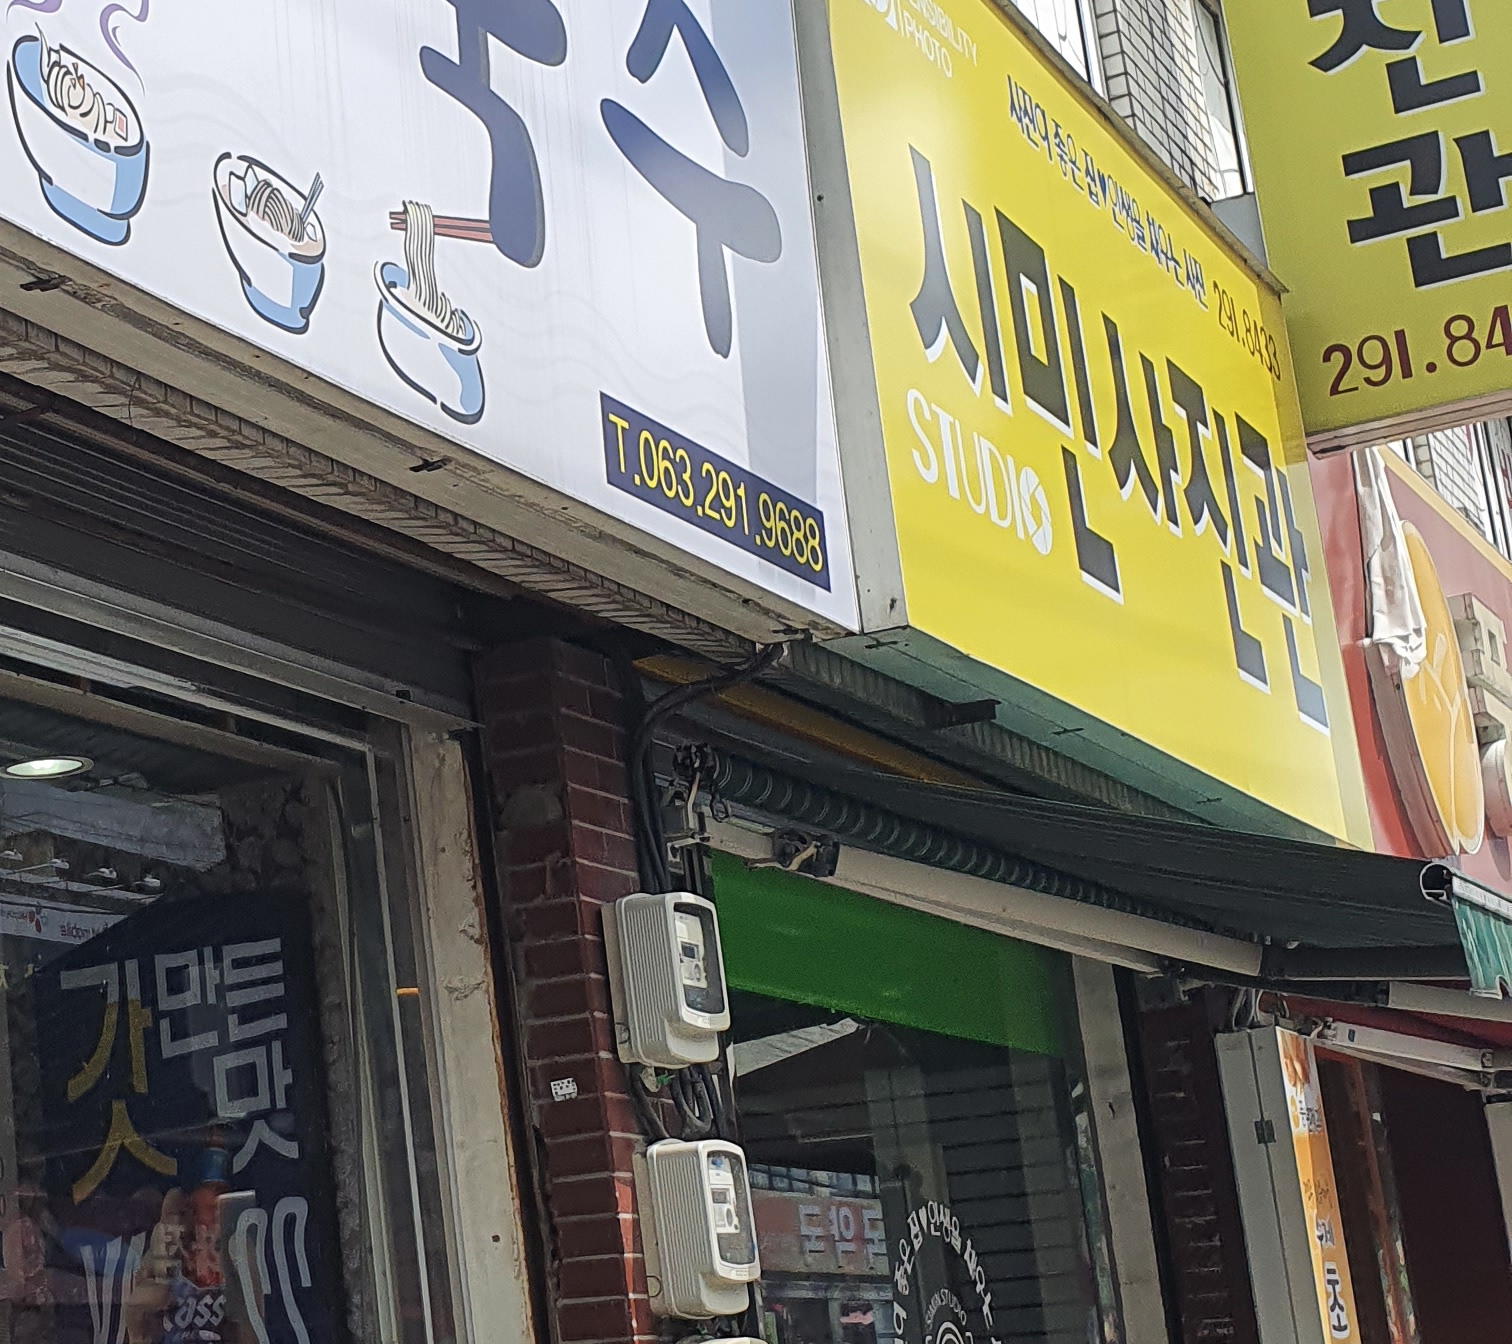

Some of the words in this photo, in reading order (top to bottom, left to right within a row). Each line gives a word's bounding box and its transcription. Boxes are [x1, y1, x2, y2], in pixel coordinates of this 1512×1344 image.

[902, 9, 953, 78] PHOTO
[1050, 117, 1085, 192] 좋은
[1212, 279, 1282, 382] 291.8433
[606, 410, 828, 574] T.063.291.9688
[904, 387, 1054, 556] STUDIO
[908, 144, 1330, 736] 시민사진관
